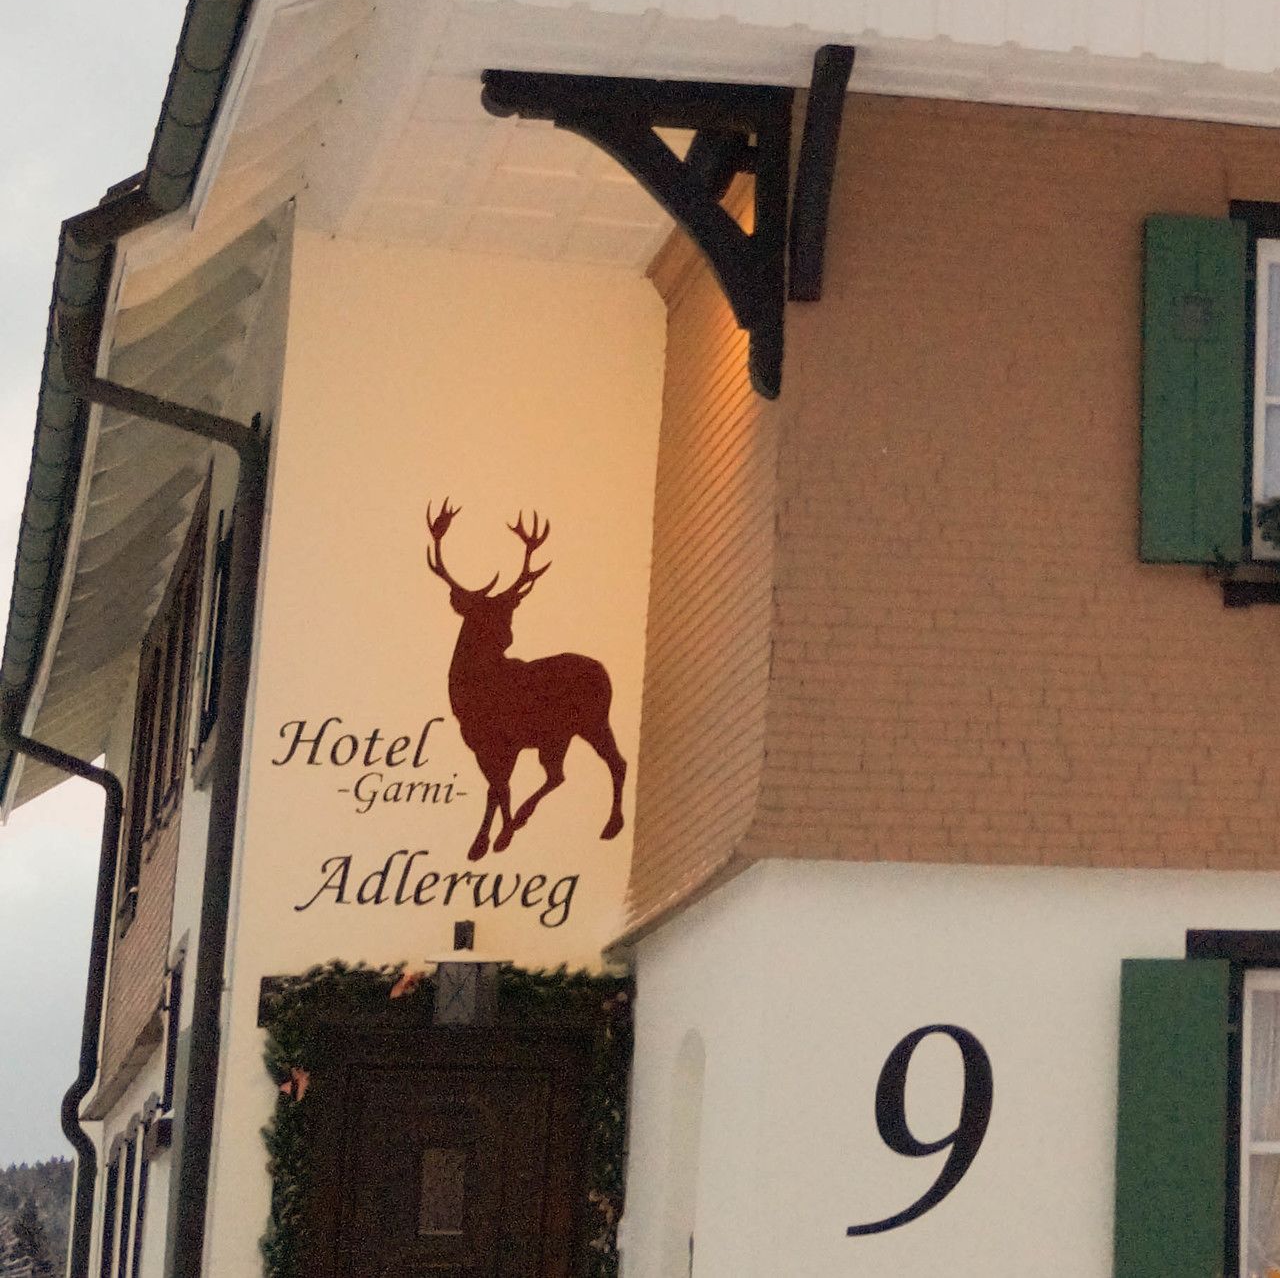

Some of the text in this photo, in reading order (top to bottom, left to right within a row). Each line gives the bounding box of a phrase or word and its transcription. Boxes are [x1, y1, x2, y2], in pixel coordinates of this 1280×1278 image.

[271, 717, 445, 768] Hotel
[293, 849, 580, 928] Adlerweg
[846, 1023, 994, 1237] 9
